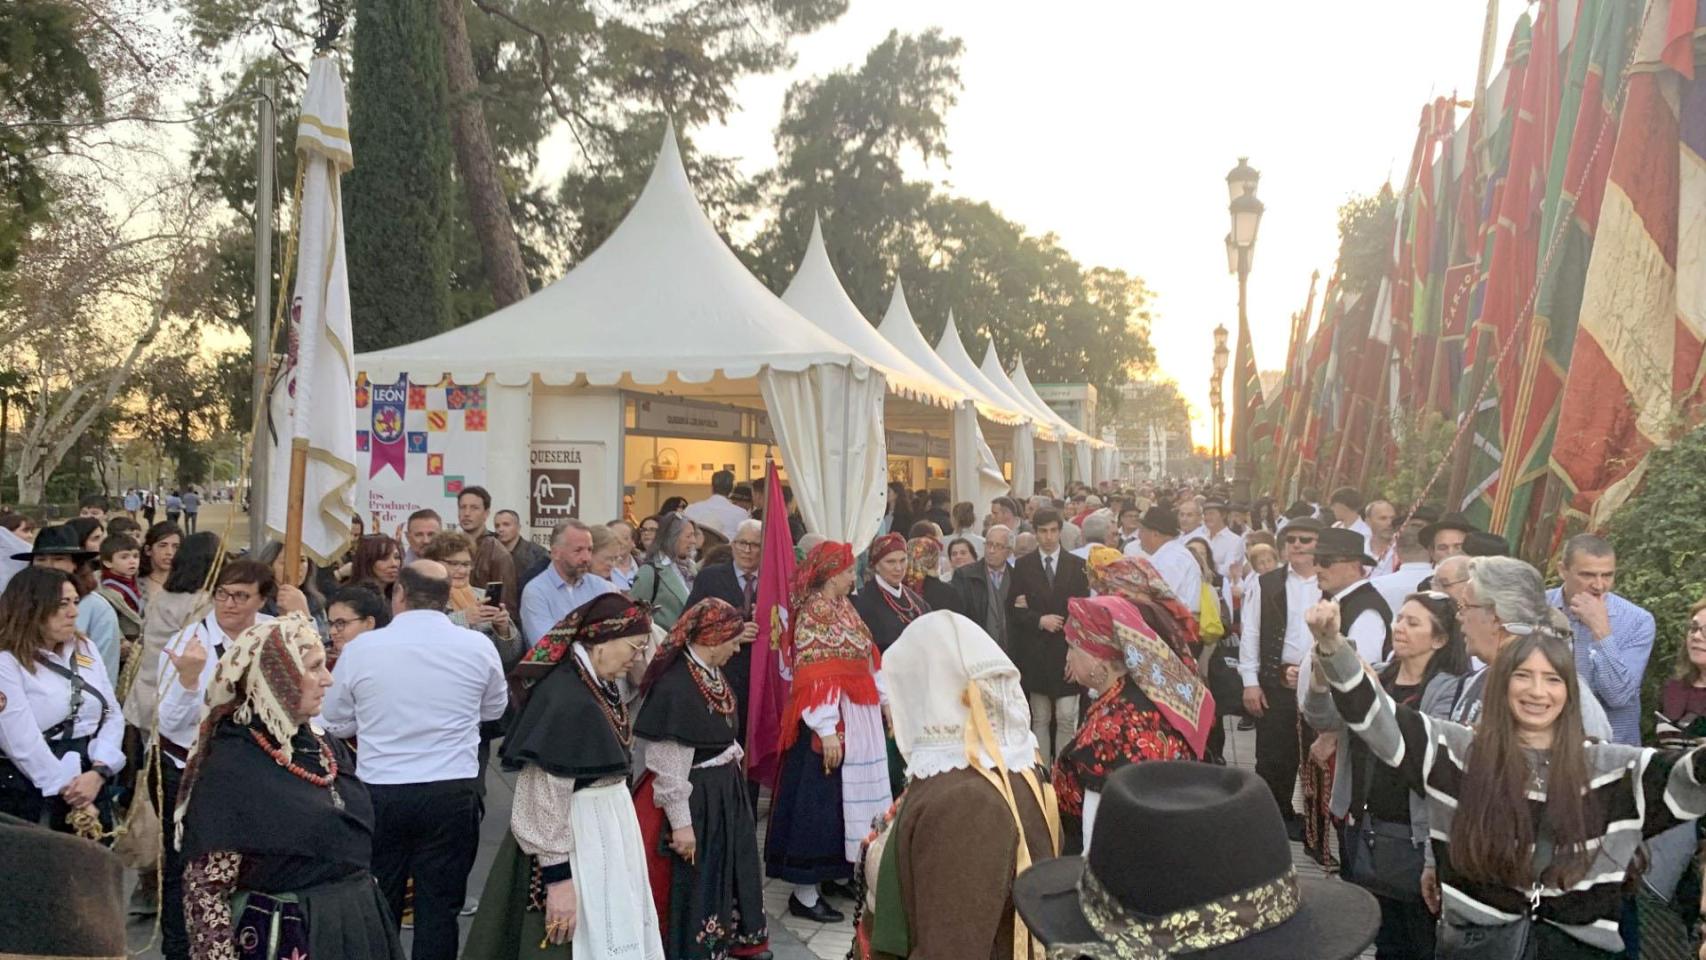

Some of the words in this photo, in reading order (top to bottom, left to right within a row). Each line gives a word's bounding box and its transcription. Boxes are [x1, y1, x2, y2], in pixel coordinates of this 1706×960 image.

[373, 387, 405, 402] LEÓN
[530, 448, 582, 464] QUESERÍA
[382, 511, 397, 522] de
